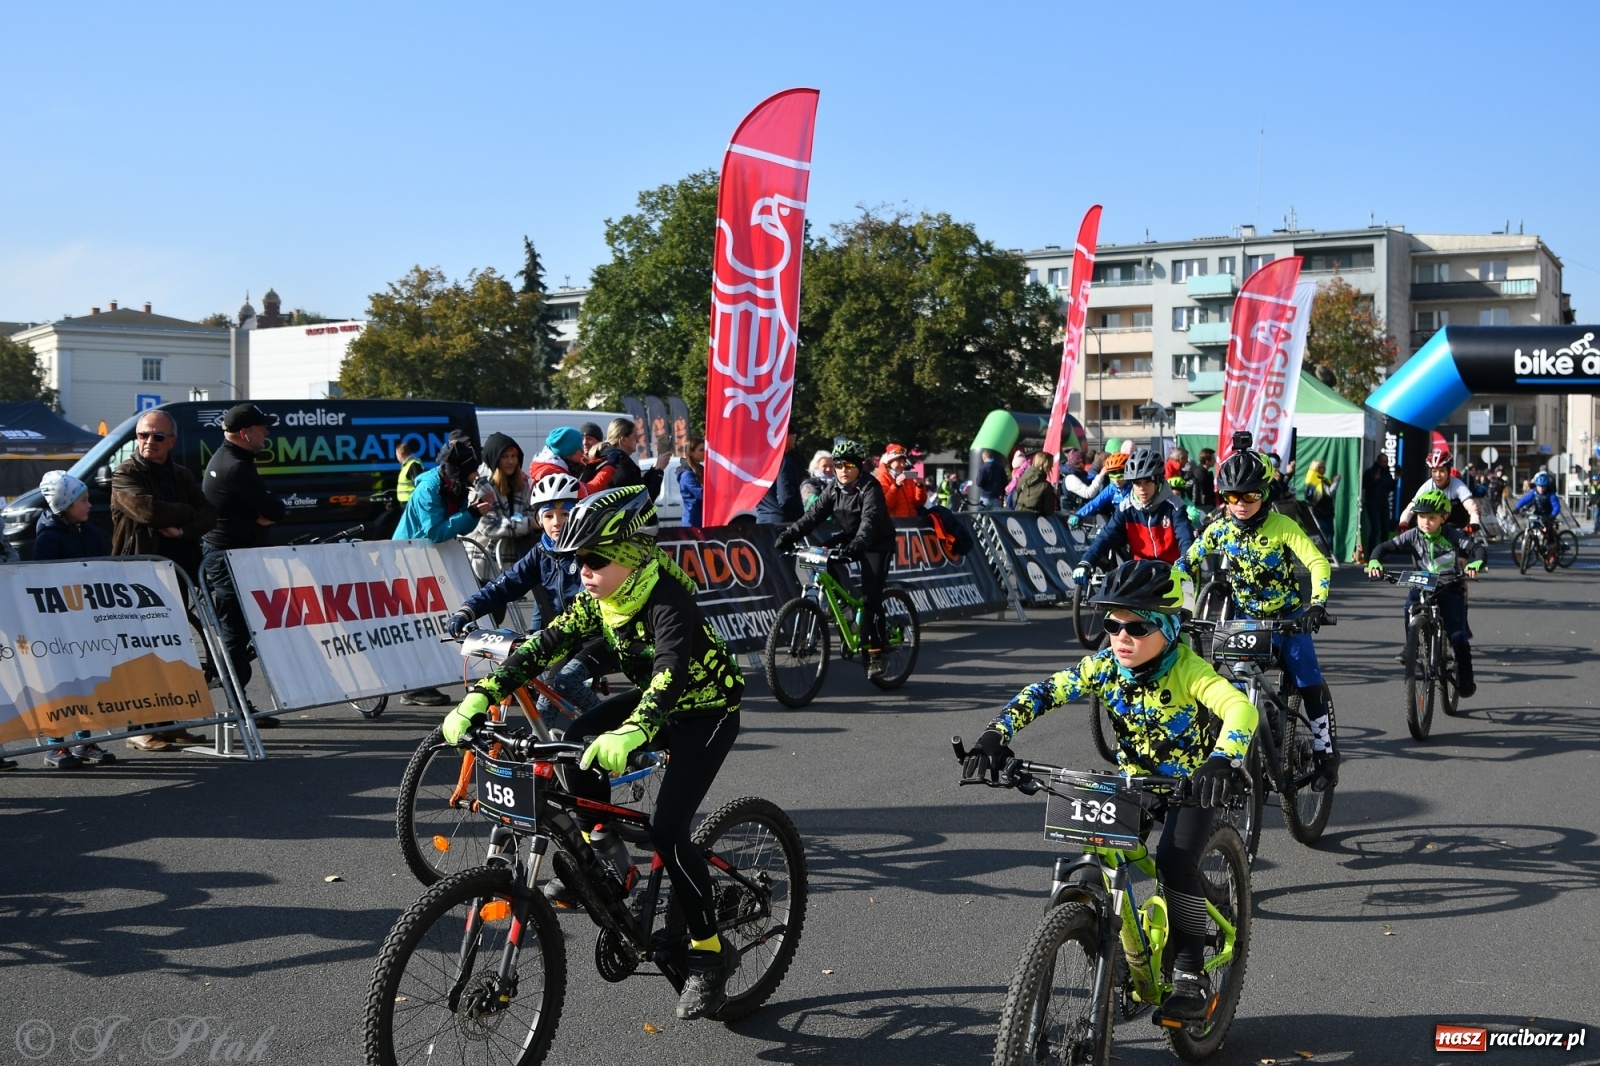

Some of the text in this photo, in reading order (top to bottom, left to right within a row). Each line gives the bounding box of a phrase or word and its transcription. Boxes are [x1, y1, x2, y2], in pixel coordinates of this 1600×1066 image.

[1514, 348, 1574, 375] bike
[285, 408, 346, 427] atelier
[328, 495, 357, 503] CST
[1408, 575, 1429, 585] 222
[26, 582, 133, 614] TAURUS
[251, 576, 449, 631] YAKIMA
[929, 583, 985, 610] NAJLEPSZYCH
[93, 612, 170, 623] gdziekolwiek jedziesz
[320, 612, 455, 660] TAKE MORE FRIE
[480, 633, 504, 645] 299
[99, 690, 202, 715] taurus.info.pl
[486, 781, 515, 807] 158
[1071, 799, 1116, 824] 138
